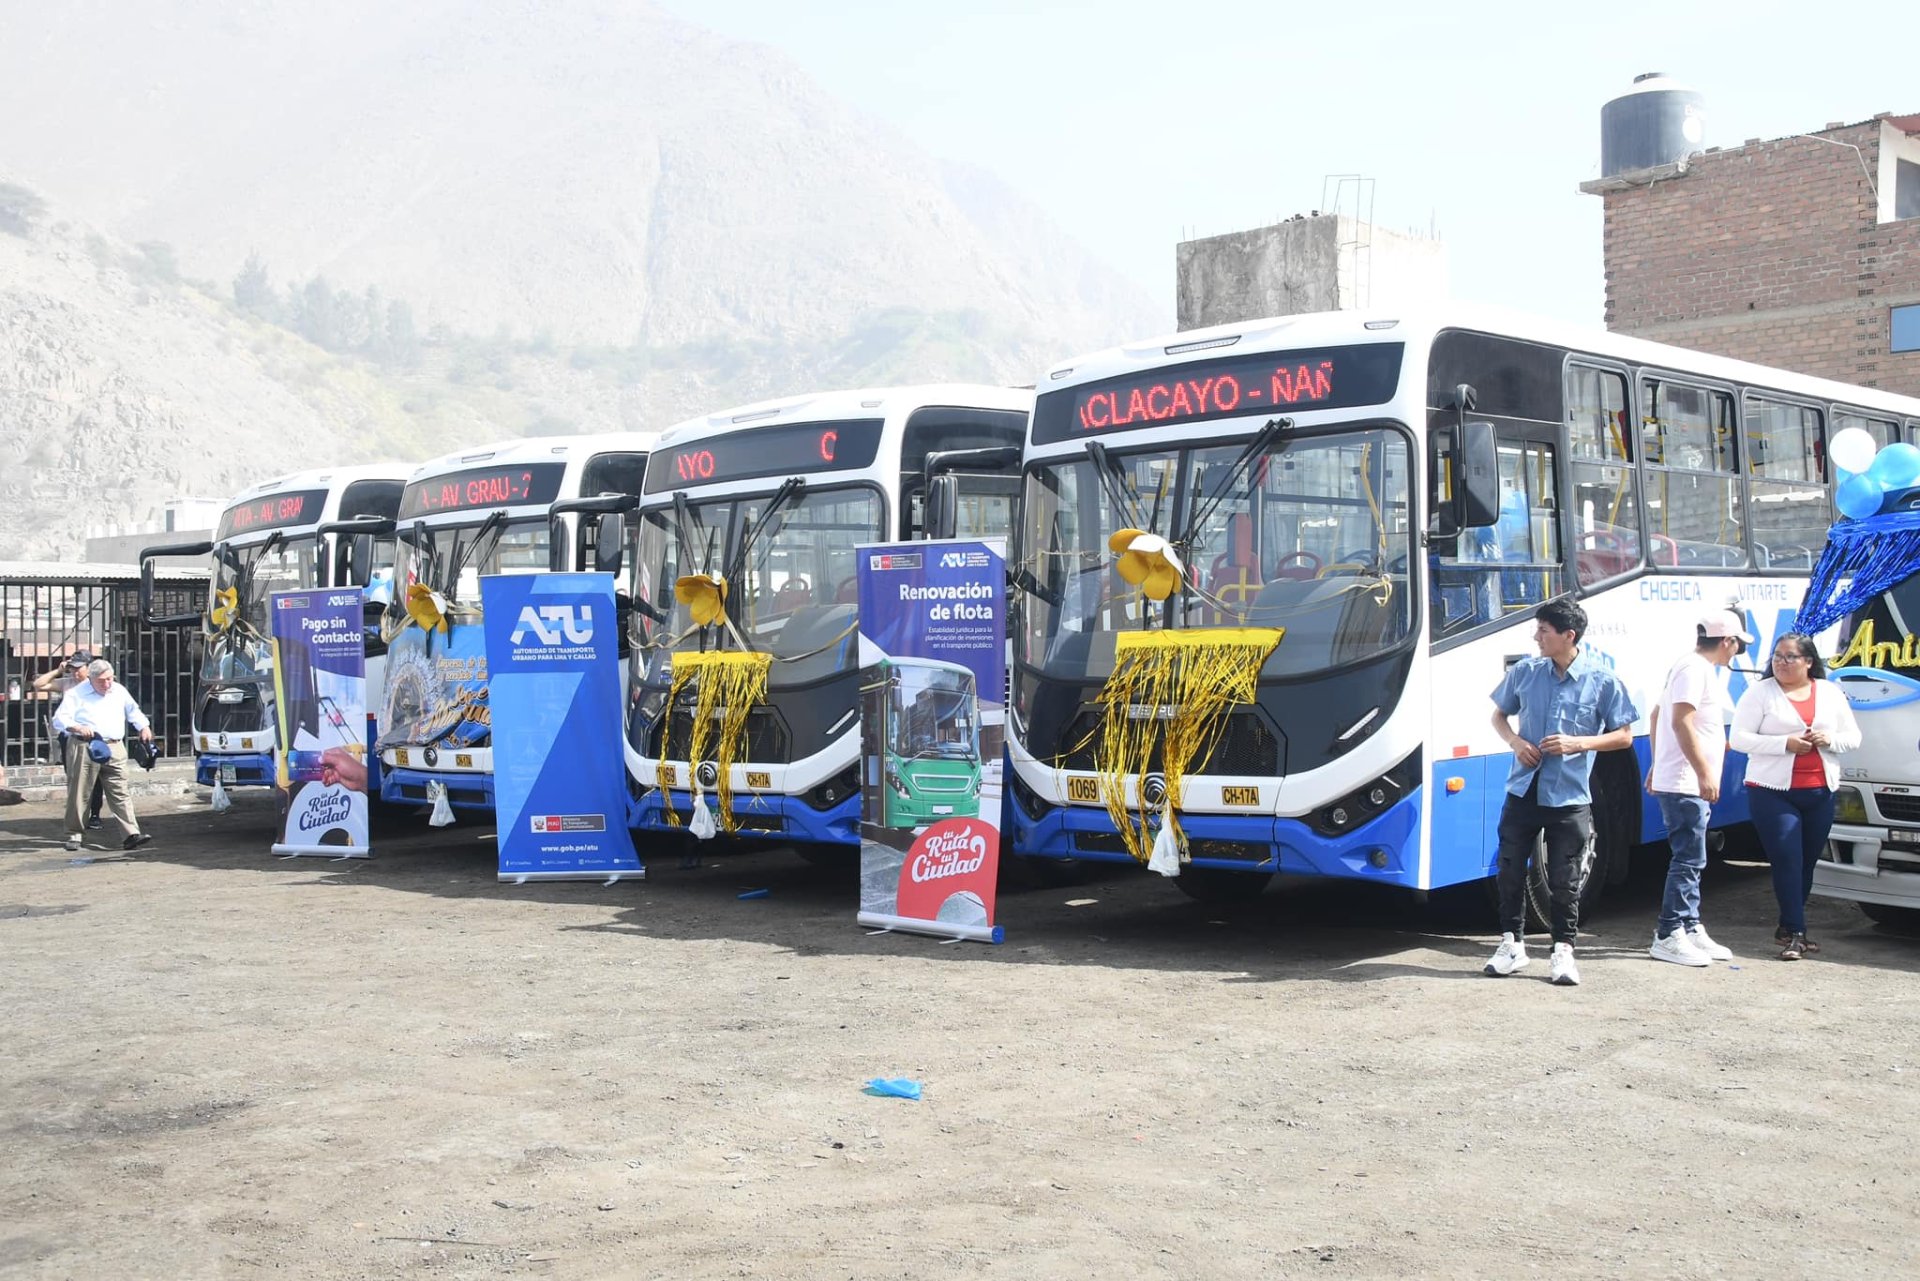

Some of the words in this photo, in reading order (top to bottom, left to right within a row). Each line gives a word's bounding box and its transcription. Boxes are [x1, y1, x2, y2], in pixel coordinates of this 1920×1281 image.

[441, 484, 462, 507] AV.
[467, 477, 510, 504] GRAU
[940, 552, 966, 568] ATU
[900, 582, 992, 600] Renovación
[1640, 581, 1700, 601] CHOSICA
[1738, 584, 1787, 600] VITARTE
[930, 604, 951, 620] de
[954, 603, 993, 620] flota
[302, 617, 329, 632] Pago
[330, 616, 346, 629] sin
[510, 605, 593, 645] ATU
[312, 631, 361, 644] contacto
[656, 766, 676, 784] 169
[747, 773, 770, 788] CH-17A
[1069, 778, 1098, 800] 1069
[1223, 788, 1258, 804] CH-17A
[309, 788, 340, 812] Ruta
[299, 795, 351, 831] Ciudad
[925, 825, 971, 858] Ruta
[943, 830, 954, 839] tu
[541, 844, 598, 853] www.gob.pe/atu
[912, 835, 986, 883] Ciudad
[941, 853, 952, 863] tu
